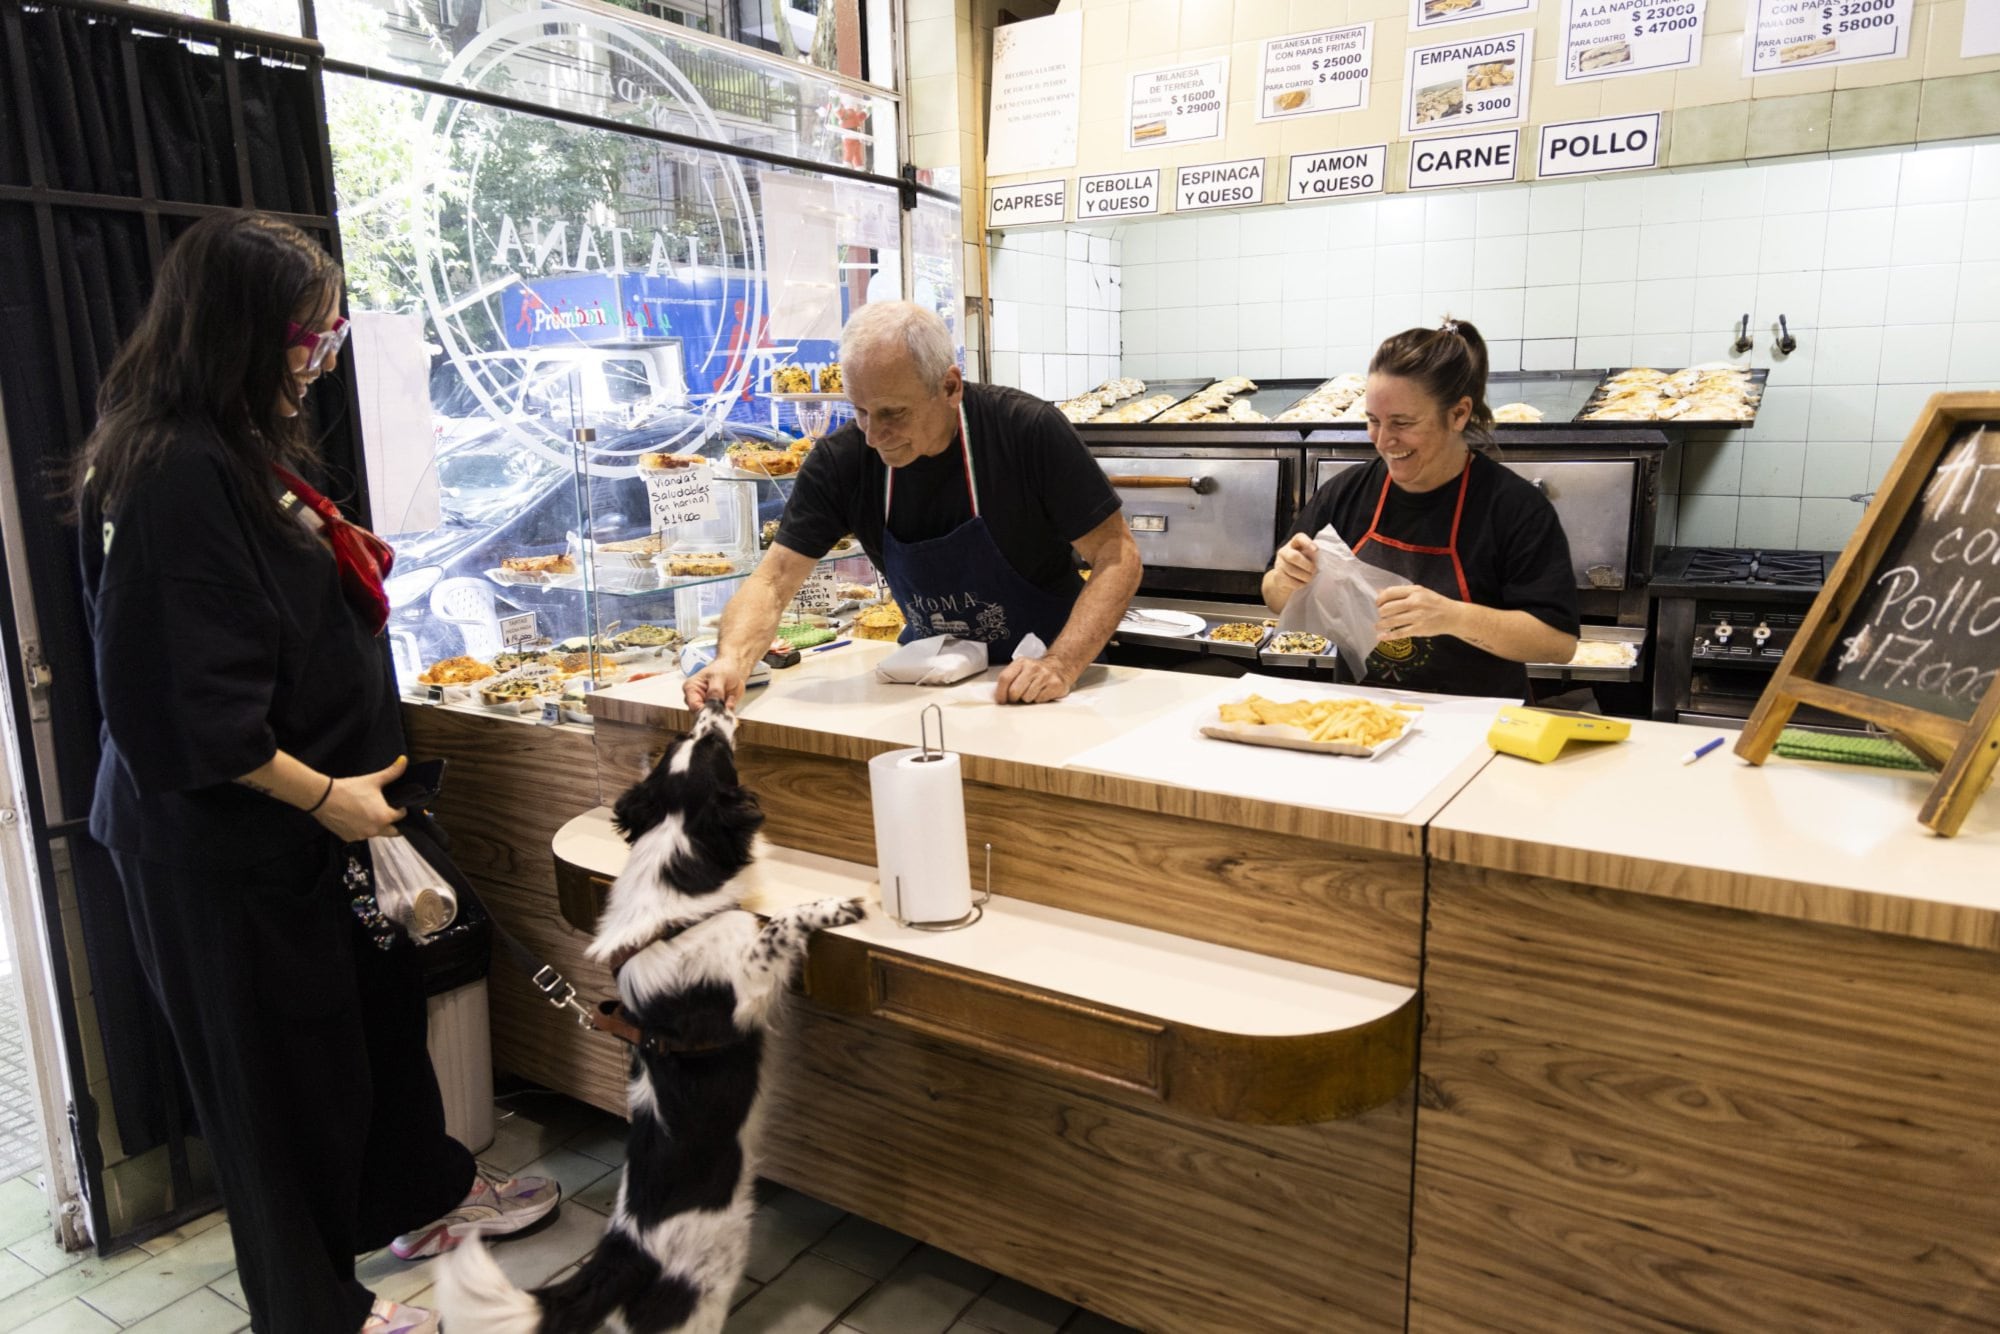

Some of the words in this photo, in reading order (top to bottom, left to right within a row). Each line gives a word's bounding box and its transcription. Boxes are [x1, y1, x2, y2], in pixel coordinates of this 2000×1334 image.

[1572, 22, 1592, 30] PARA
[1594, 18, 1611, 26] DOS
[1632, 11, 1640, 22] $
[1646, 4, 1696, 20] 23000
[1580, 8, 1588, 18] A
[1592, 6, 1606, 16] LA
[1772, 2, 1798, 15] CON
[1785, 16, 1805, 25] DOS
[1822, 7, 1832, 19] $
[1839, 0, 1894, 16] 32000
[1634, 25, 1644, 36] $
[1648, 16, 1698, 34] 47000
[1822, 23, 1832, 36] $
[1838, 14, 1894, 32] 58000
[1271, 39, 1310, 51] MILANESA
[1312, 37, 1322, 45] DE
[1325, 30, 1362, 42] TERNERA
[1570, 39, 1591, 48] PARA
[1592, 33, 1626, 44] CUATRO
[1758, 38, 1782, 48] PARA
[1275, 50, 1294, 60] CON
[1296, 46, 1324, 57] PAPAS
[1326, 41, 1357, 53] FRITAS
[1420, 40, 1516, 66] EMPANADAS
[1312, 60, 1320, 70] $
[1323, 54, 1362, 69] 25000
[1156, 68, 1200, 82] MILANESA
[1318, 73, 1326, 84] $
[1330, 68, 1369, 82] 40000
[1150, 86, 1162, 94] DE
[1164, 80, 1205, 92] TERNERA
[1265, 84, 1284, 92] PARA
[1285, 80, 1314, 89] CUATRO
[1170, 95, 1178, 105] $
[1182, 90, 1216, 102] 16000
[1464, 103, 1474, 114] $
[1477, 97, 1512, 112] 3000
[1176, 106, 1184, 116] $
[1187, 101, 1220, 114] 29000
[1550, 130, 1648, 160] POLLO
[1307, 154, 1368, 174] JAMON
[1416, 144, 1512, 173] CARNE
[1086, 176, 1152, 194] CEBOLLA
[1182, 166, 1260, 187] ESPINACA
[1298, 181, 1308, 194] Y
[1313, 174, 1374, 192] QUESO
[993, 191, 1064, 212] CAPRESE
[1086, 200, 1096, 212] Y
[1098, 195, 1150, 212] QUESO
[1186, 192, 1196, 206] Y
[1198, 186, 1254, 204] QUESO
[654, 472, 697, 488] Viandas
[651, 484, 710, 502] Saludables
[1932, 526, 2000, 566] co
[1877, 565, 2000, 636] Pollo
